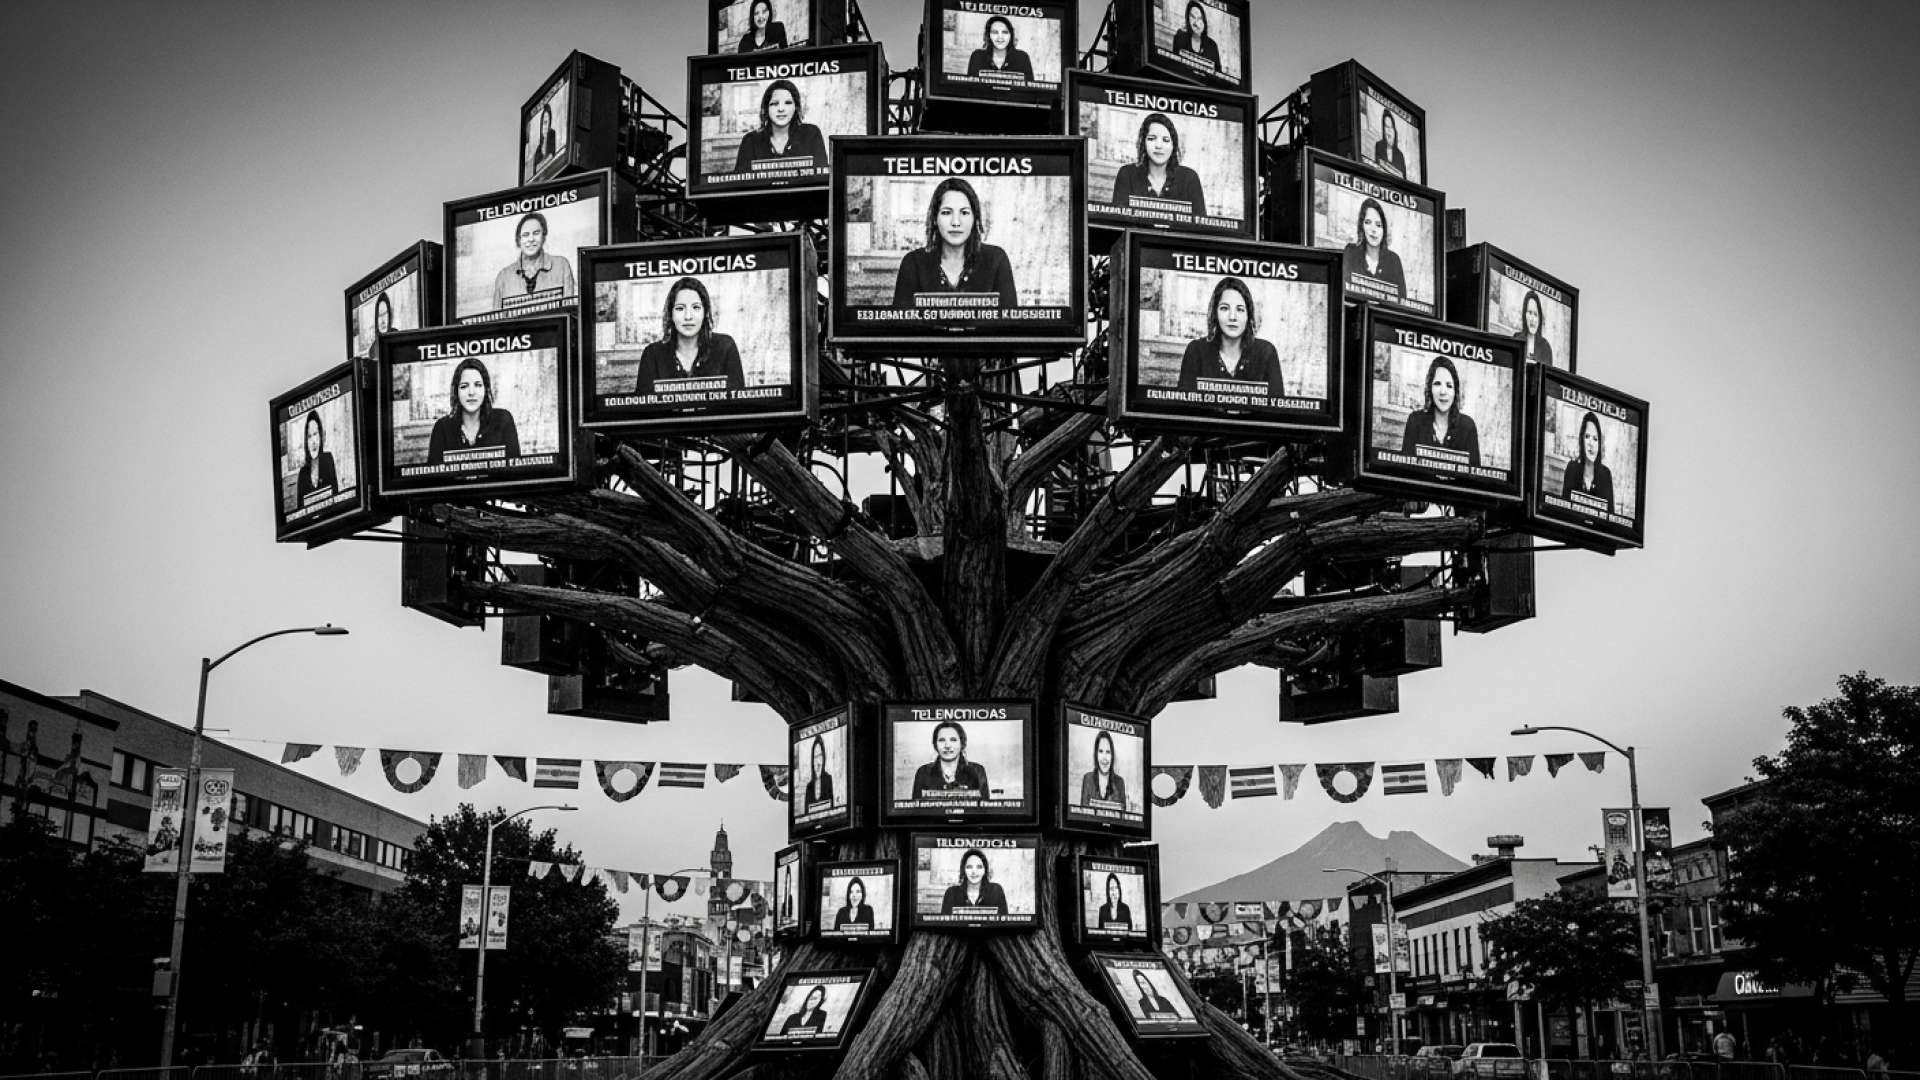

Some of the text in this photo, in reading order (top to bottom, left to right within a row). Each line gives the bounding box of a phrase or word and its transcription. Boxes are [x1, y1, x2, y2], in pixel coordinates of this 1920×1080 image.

[727, 60, 840, 81] TELENOTICIAS
[1105, 89, 1218, 118] TELENOTICIAS
[883, 157, 1033, 174] TELENOTICIAS
[624, 254, 757, 278] TELENOTICIAS
[1172, 253, 1299, 279] TELENOTICIAS
[418, 334, 532, 360] TELENOTICIAS
[1395, 328, 1493, 362] TELENOTICIAS
